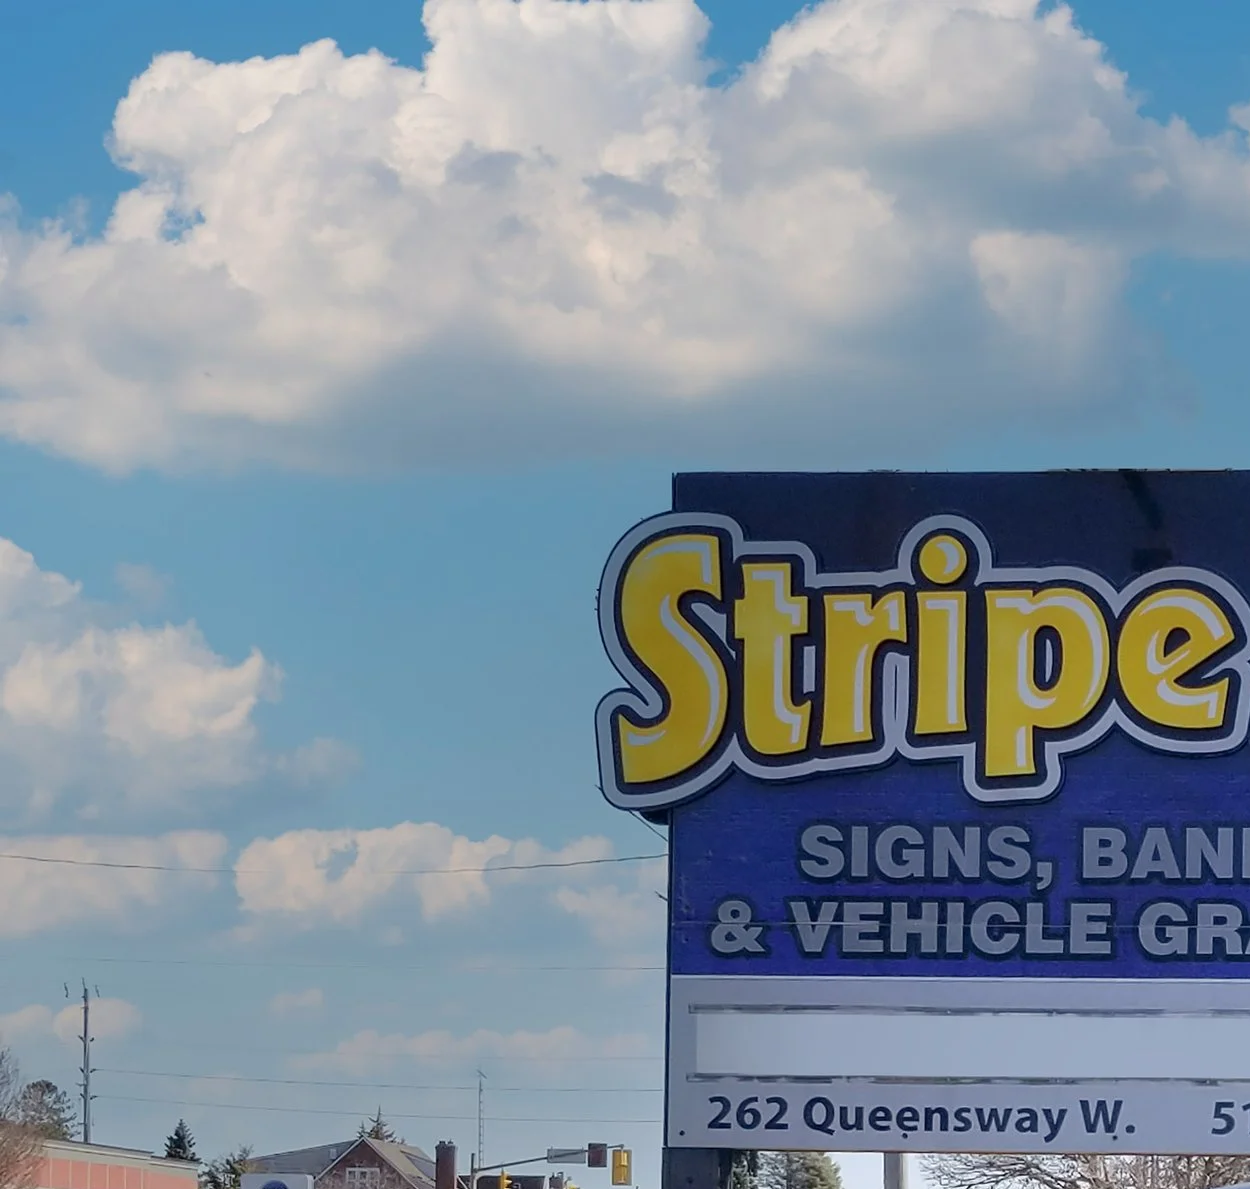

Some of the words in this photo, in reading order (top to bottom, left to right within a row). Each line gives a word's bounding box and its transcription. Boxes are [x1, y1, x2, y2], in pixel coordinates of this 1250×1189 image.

[800, 824, 1054, 891] SIGNS,
[710, 900, 766, 955] &
[789, 901, 1113, 955] VEHICLE
[707, 1096, 789, 1130] 262
[803, 1096, 1068, 1143] Queensway
[1079, 1099, 1136, 1134] W.
